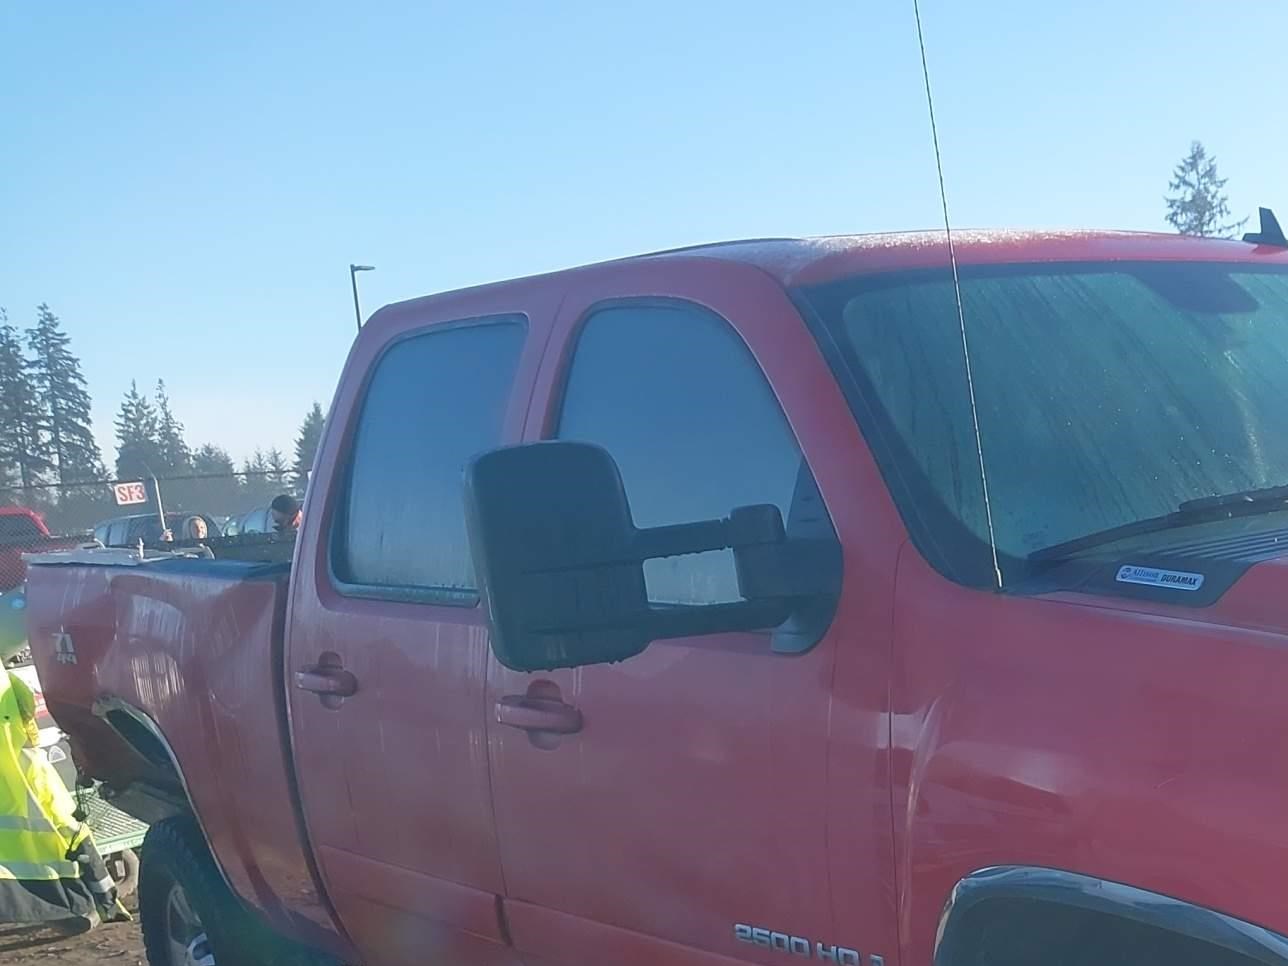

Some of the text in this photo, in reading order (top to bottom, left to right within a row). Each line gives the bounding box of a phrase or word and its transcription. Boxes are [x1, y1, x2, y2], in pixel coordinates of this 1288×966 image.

[117, 484, 145, 502] SF3
[1160, 574, 1200, 586] DURAMAX
[735, 923, 811, 958] 2500
